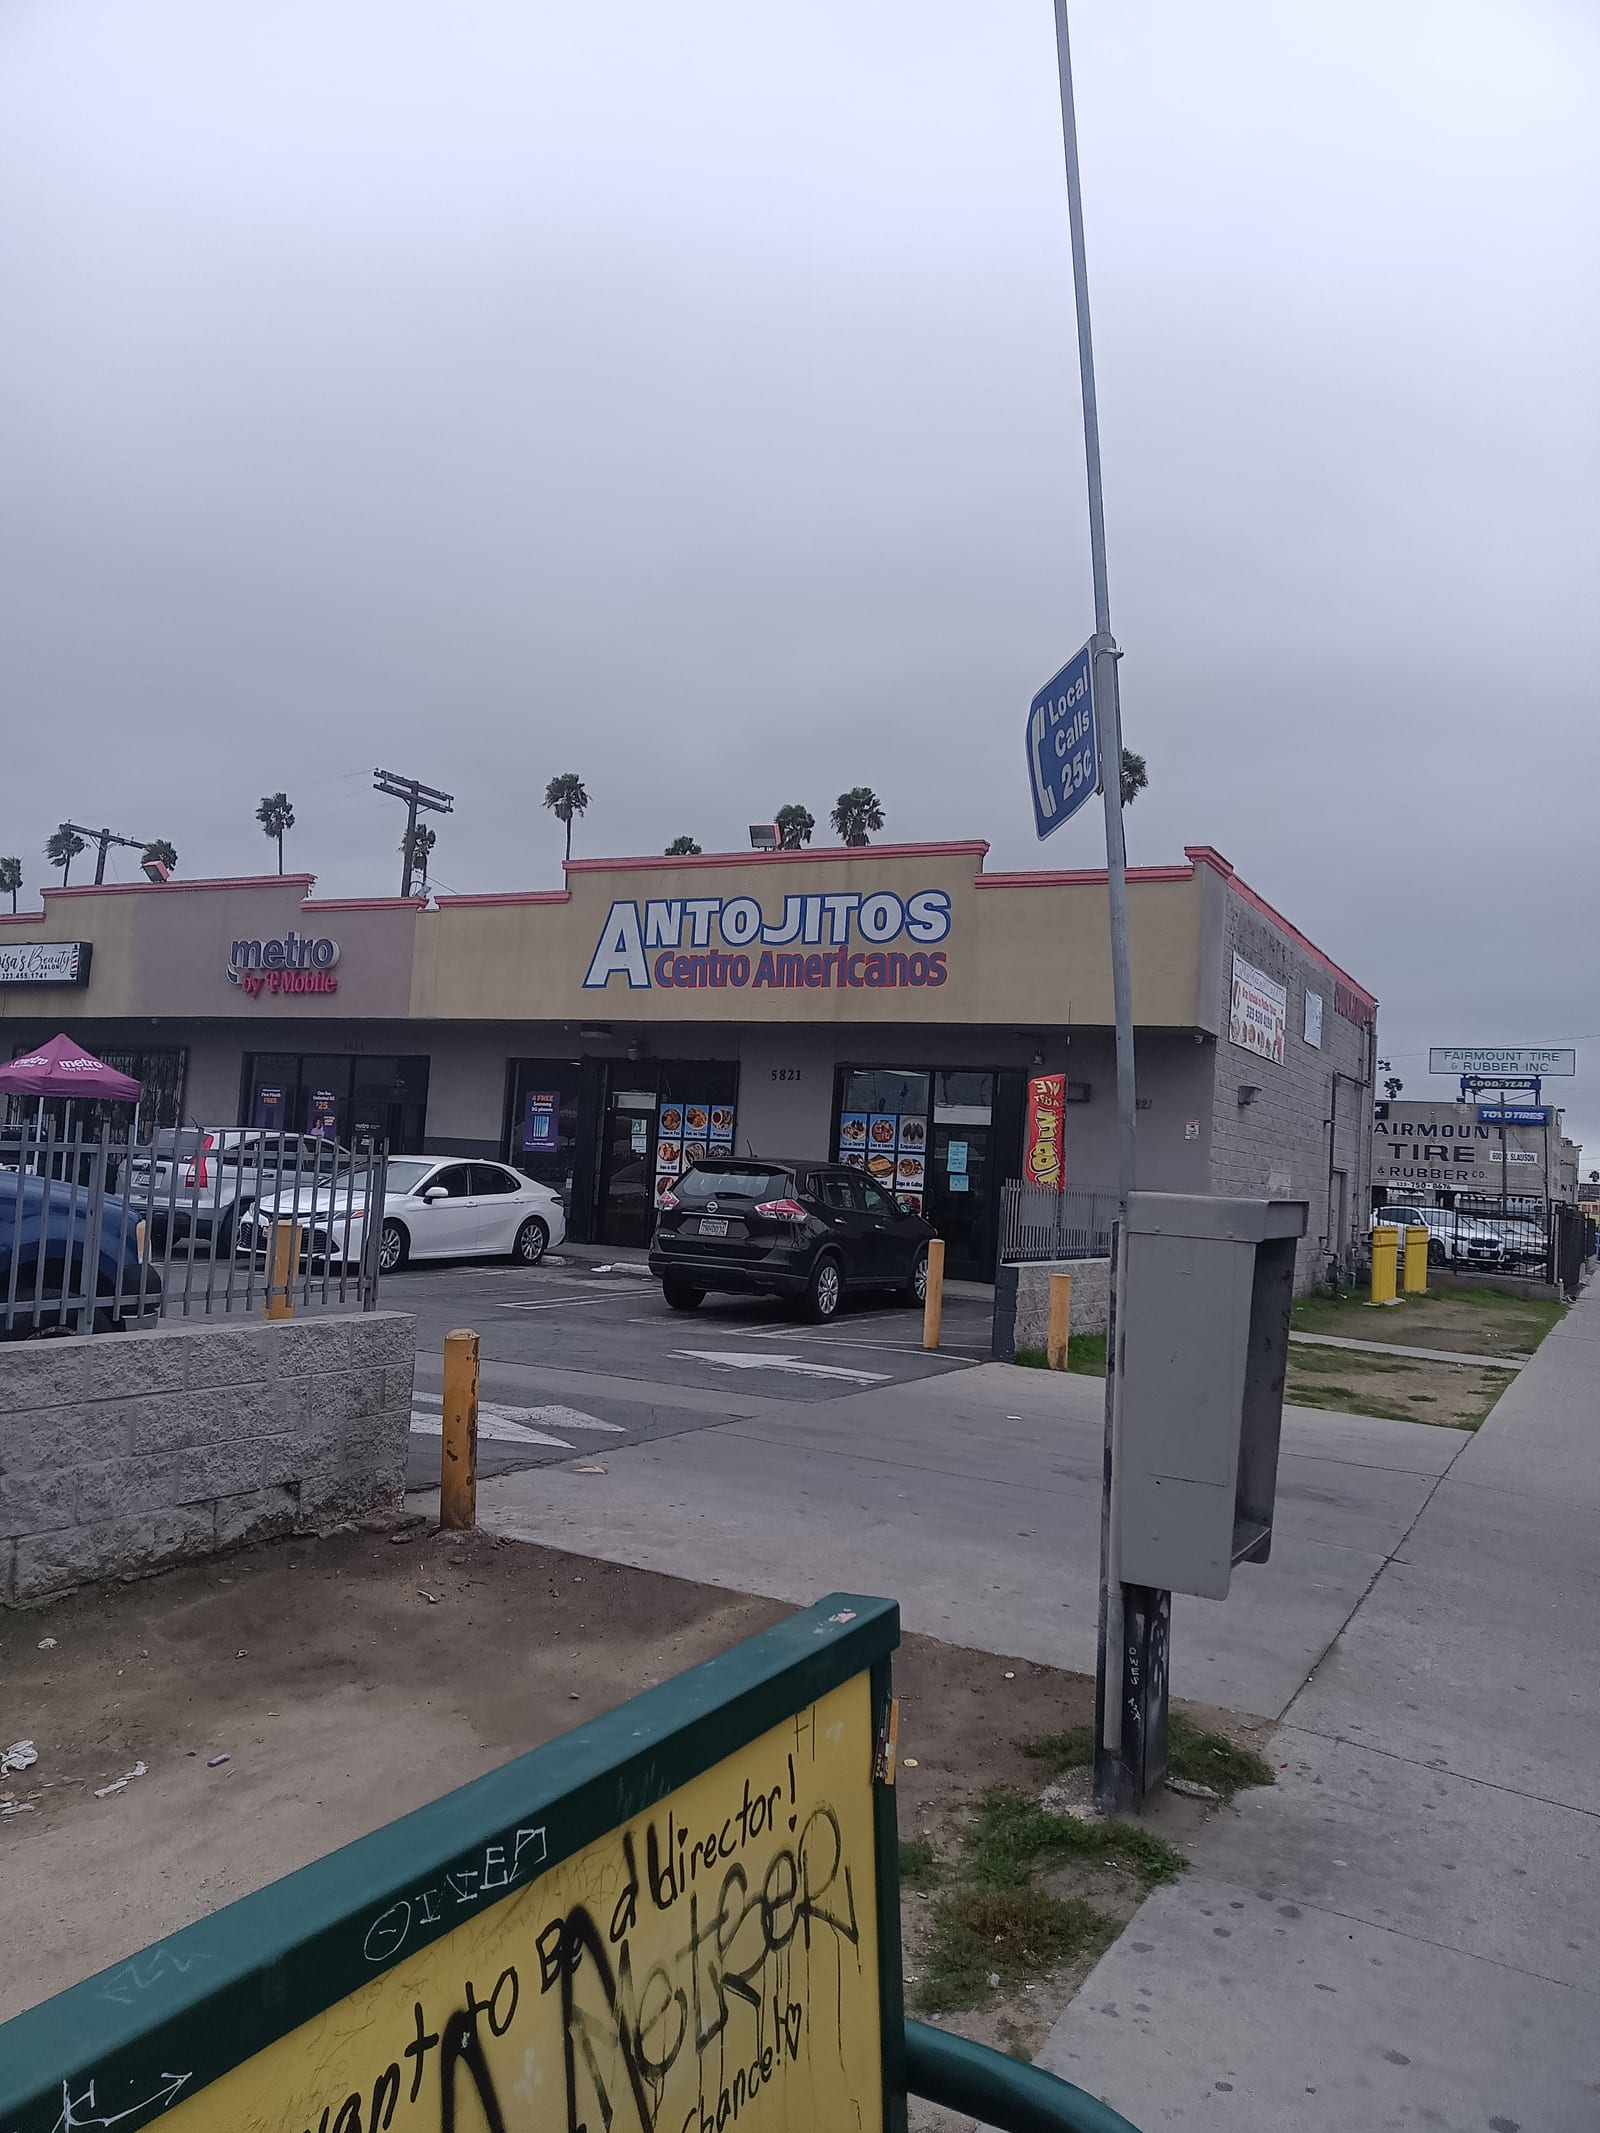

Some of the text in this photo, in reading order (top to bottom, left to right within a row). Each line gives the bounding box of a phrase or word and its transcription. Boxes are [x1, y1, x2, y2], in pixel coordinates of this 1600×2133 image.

[1048, 664, 1089, 726] Local
[1055, 709, 1090, 758] Calls
[1061, 744, 1092, 801] 25¢
[230, 930, 339, 969] metro
[582, 889, 951, 989] ANTOJITOS
[0, 945, 72, 974] isa's Beauty
[654, 946, 948, 988] Centro Americanos
[241, 973, 266, 1000] by
[59, 1058, 104, 1069] metro
[1444, 1051, 1561, 1062] FAIRMOUNT TIRE
[1463, 1062, 1519, 1072] RUBBER
[771, 1069, 802, 1081] 5821
[1511, 1111, 1546, 1120] TIRES
[633, 1122, 641, 1132] A
[1387, 1142, 1475, 1163] TIRE
[1510, 1153, 1536, 1163] SLAUSON
[1377, 1166, 1385, 1175] &
[1389, 1166, 1469, 1181] RUBBER
